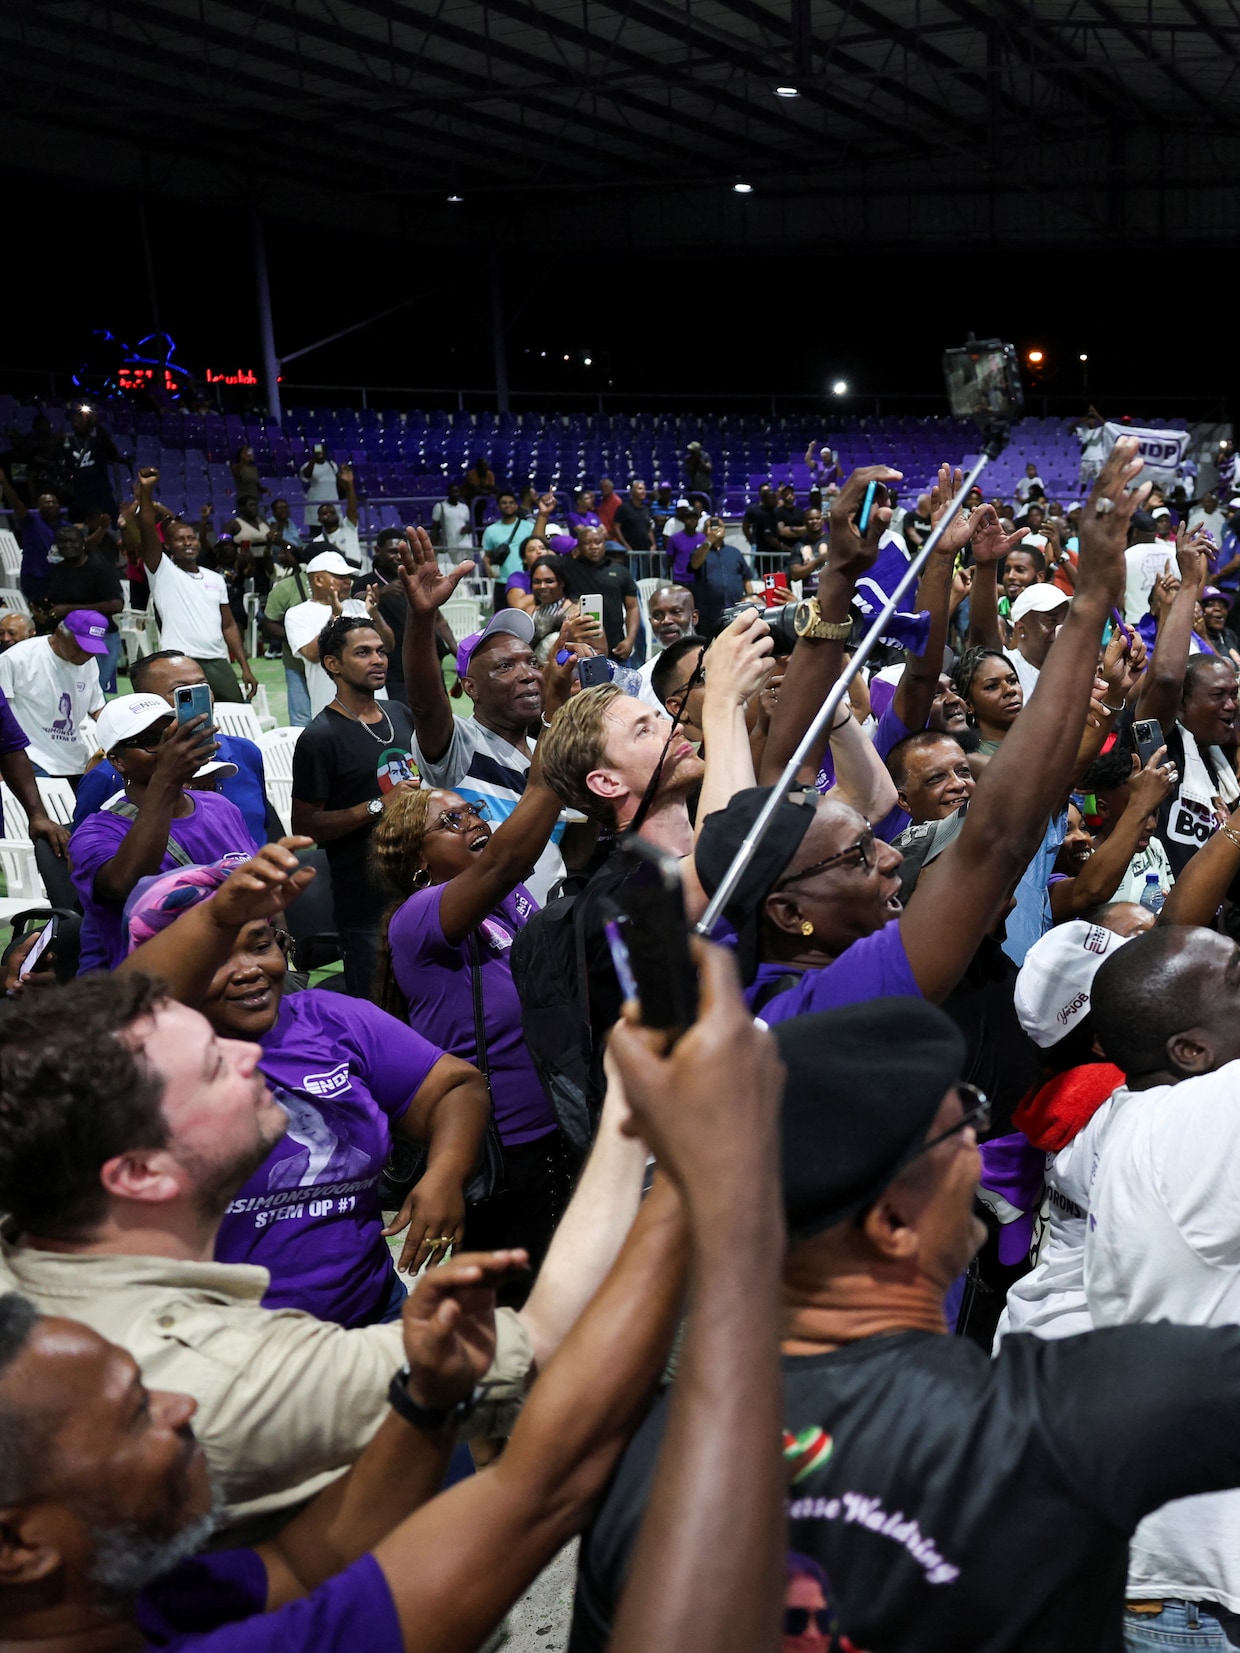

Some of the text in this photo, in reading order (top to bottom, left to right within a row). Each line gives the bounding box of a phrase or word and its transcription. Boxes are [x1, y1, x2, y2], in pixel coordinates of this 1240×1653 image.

[254, 1195, 356, 1228] STEM OP #1
